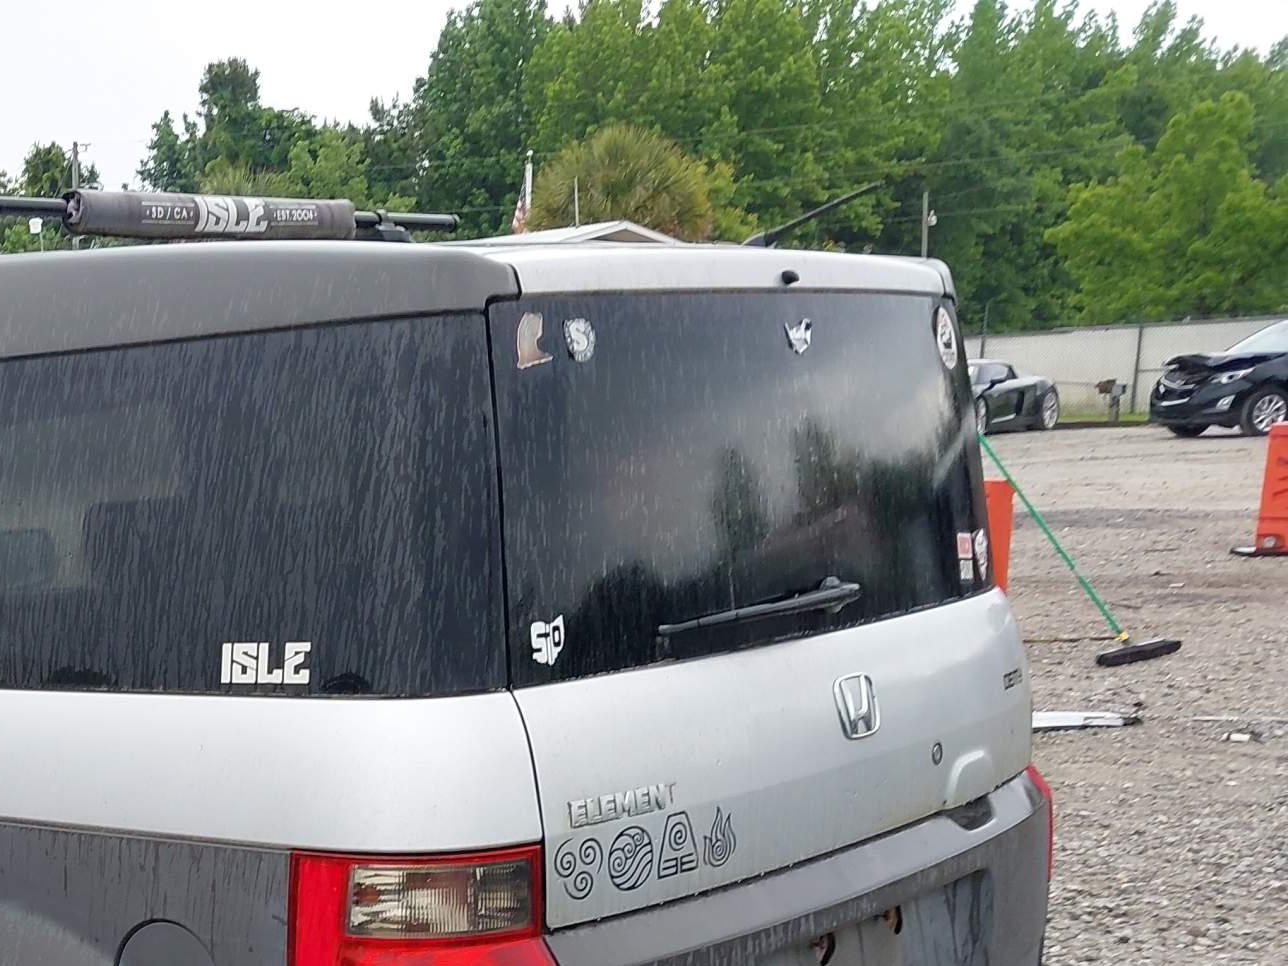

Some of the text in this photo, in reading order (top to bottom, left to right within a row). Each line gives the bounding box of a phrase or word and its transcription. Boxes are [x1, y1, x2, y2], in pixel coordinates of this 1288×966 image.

[194, 197, 268, 233] ISLE
[220, 641, 312, 685] ISLE
[567, 781, 677, 829] ELEMENT
